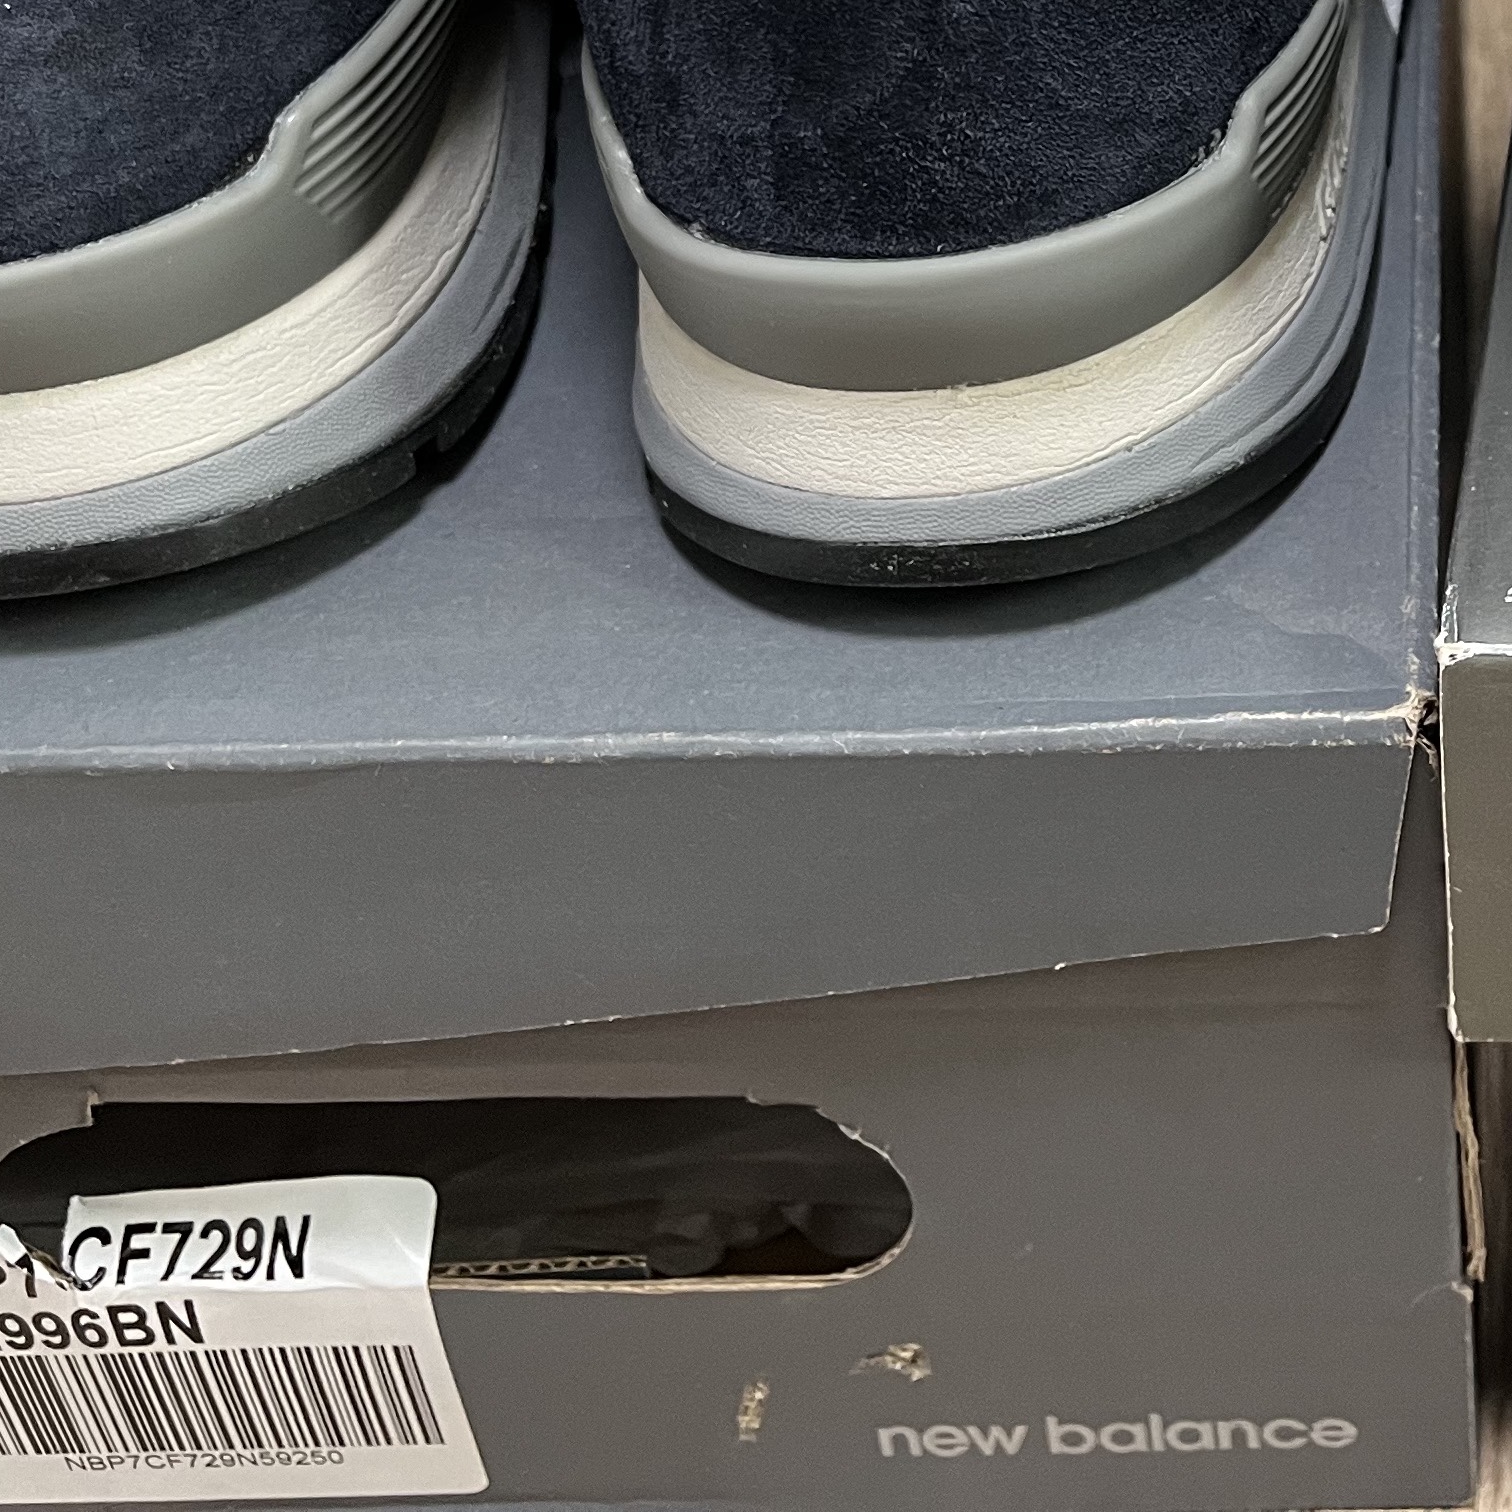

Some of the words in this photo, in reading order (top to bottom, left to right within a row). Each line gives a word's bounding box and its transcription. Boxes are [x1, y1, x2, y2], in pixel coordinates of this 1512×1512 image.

[0, 1299, 204, 1351] 996BN
[877, 1423, 1029, 1459] new
[1045, 1412, 1360, 1456] balance
